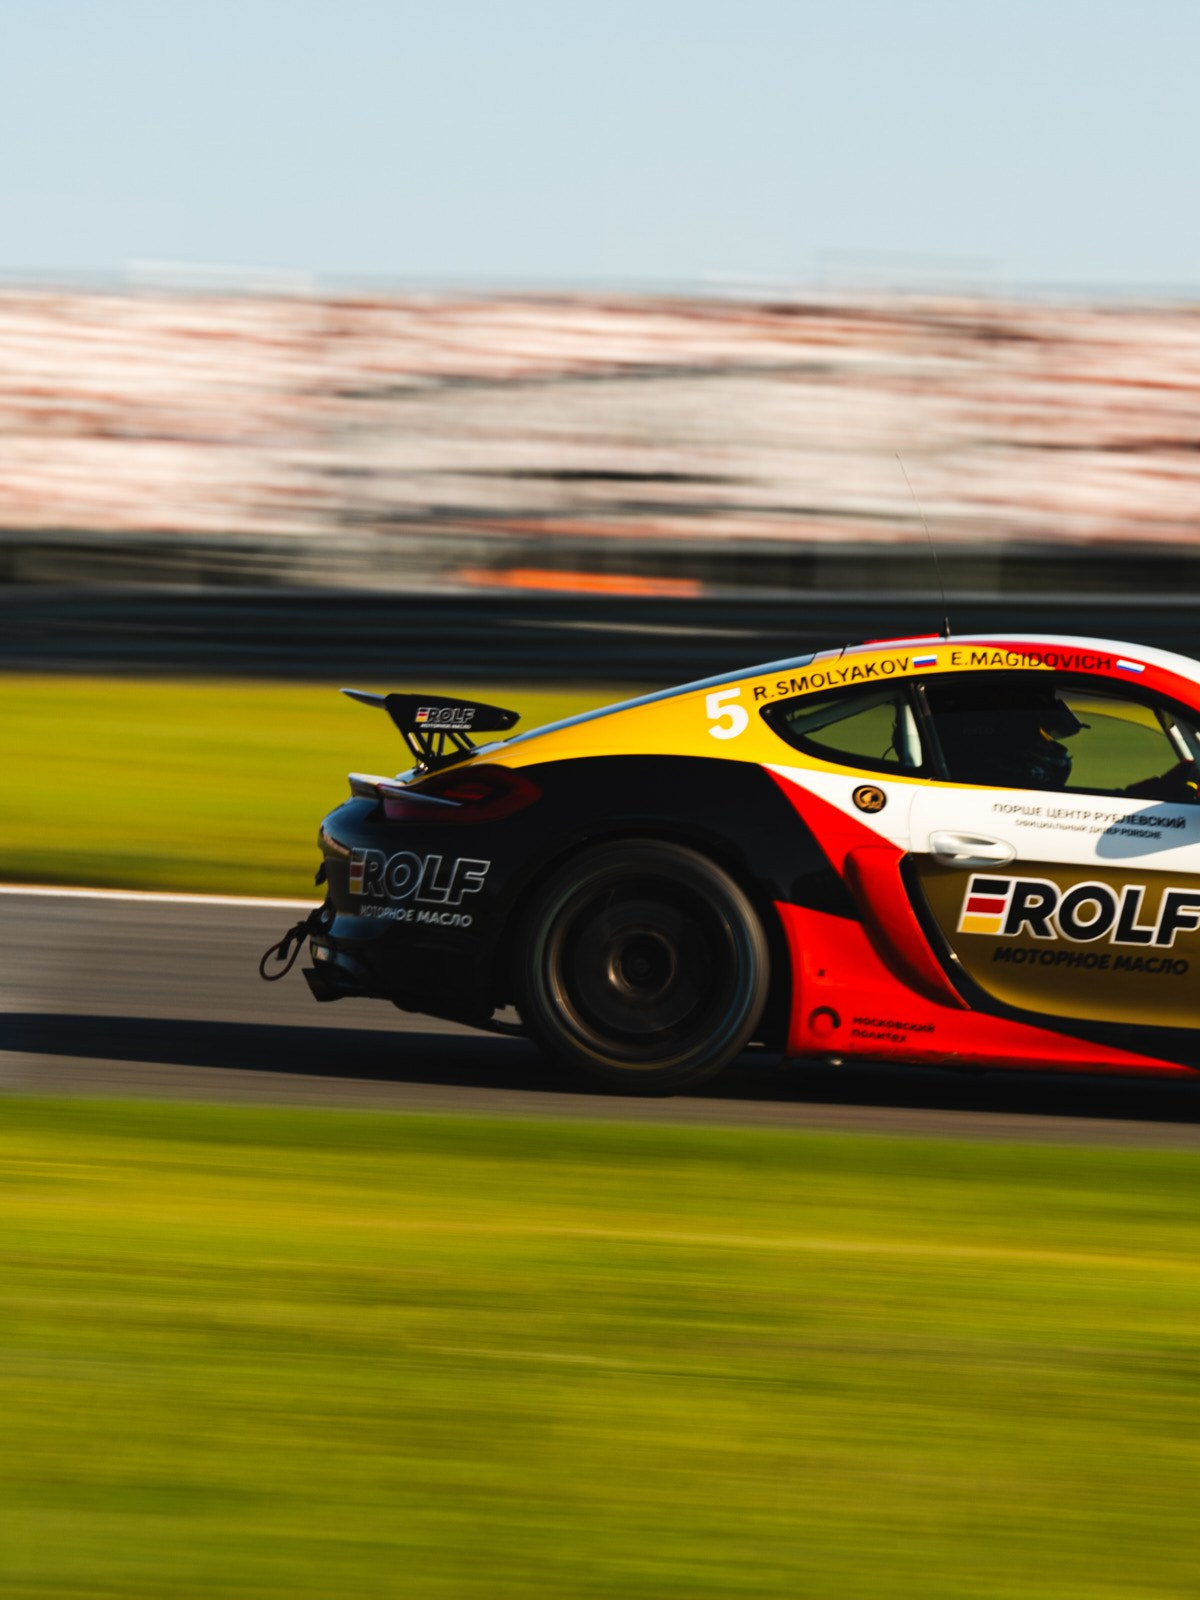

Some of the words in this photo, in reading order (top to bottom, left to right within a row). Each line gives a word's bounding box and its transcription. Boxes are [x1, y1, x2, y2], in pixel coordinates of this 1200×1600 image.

[950, 650, 1112, 671] E.MAGIDOVICH
[753, 656, 912, 701] R.SMOLYAKOV
[426, 707, 476, 723] ROLF
[705, 687, 749, 740] 5
[993, 803, 1042, 816] ПОРШЕ
[1046, 806, 1091, 819] ЦЕНТР
[362, 849, 491, 905] ROLF
[359, 904, 416, 922] МОТОРНОЕ
[416, 910, 474, 928] МАСЛО
[992, 946, 1112, 971] МОТОРНОЕ
[1113, 955, 1190, 976] МАСЛО
